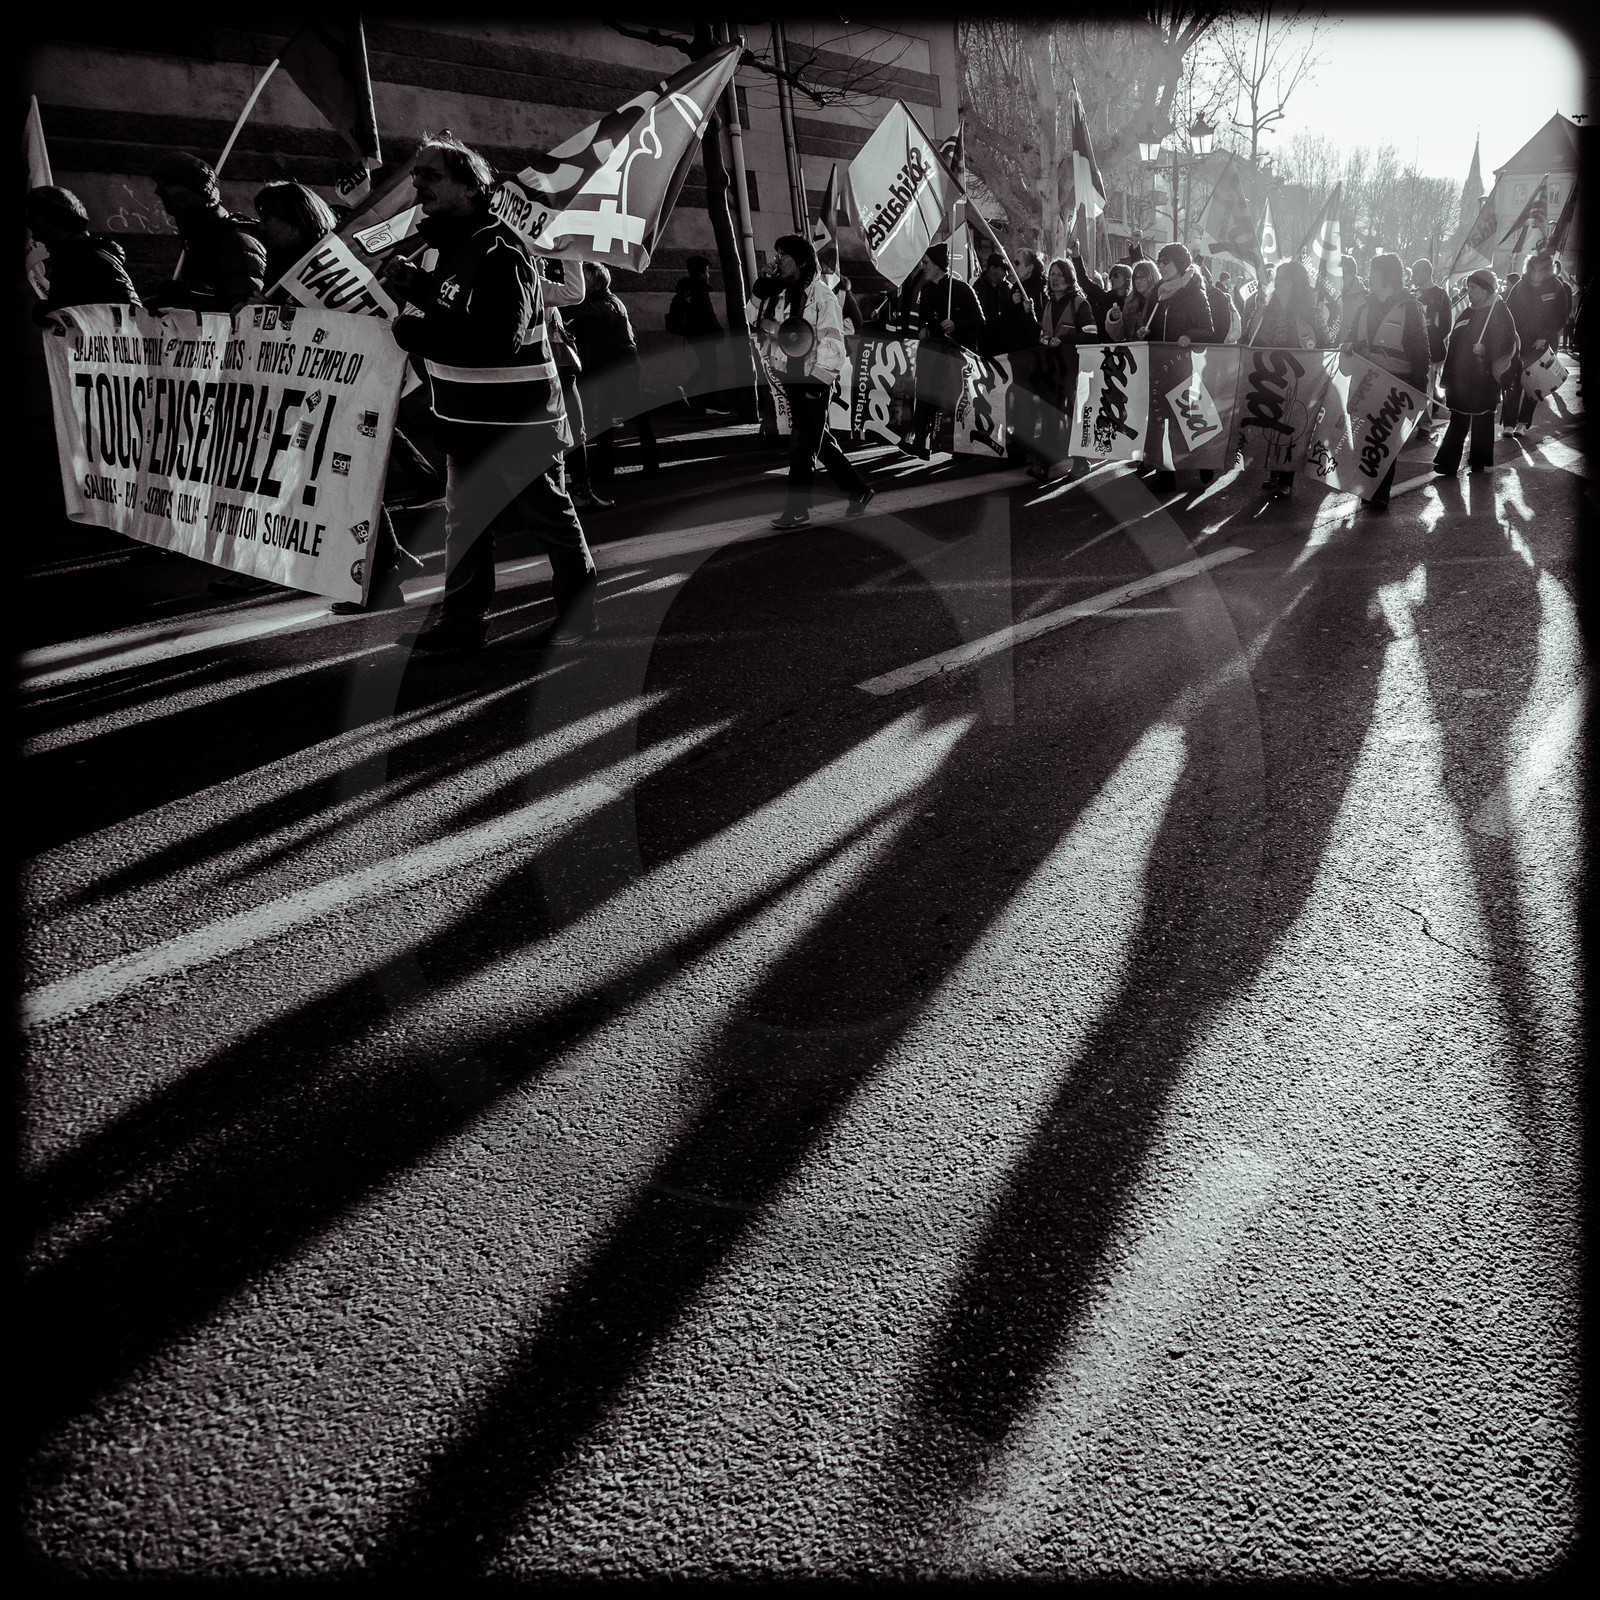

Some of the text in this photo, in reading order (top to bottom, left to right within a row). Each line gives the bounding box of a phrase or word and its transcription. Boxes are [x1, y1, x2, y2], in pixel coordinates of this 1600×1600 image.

[361, 223, 393, 252] la
[265, 309, 277, 325] FO
[257, 337, 296, 375] PRIVÉS
[297, 346, 364, 385] D'EMPLOI
[854, 341, 875, 432] Territoriaux
[863, 341, 907, 445] Sud
[1240, 350, 1305, 435] Sud
[75, 373, 145, 471] TOUS
[148, 378, 306, 498] ENSEMBLE
[1175, 389, 1218, 441] Sud
[1358, 387, 1414, 478] Snupfen
[262, 512, 326, 557] SOCIALE
